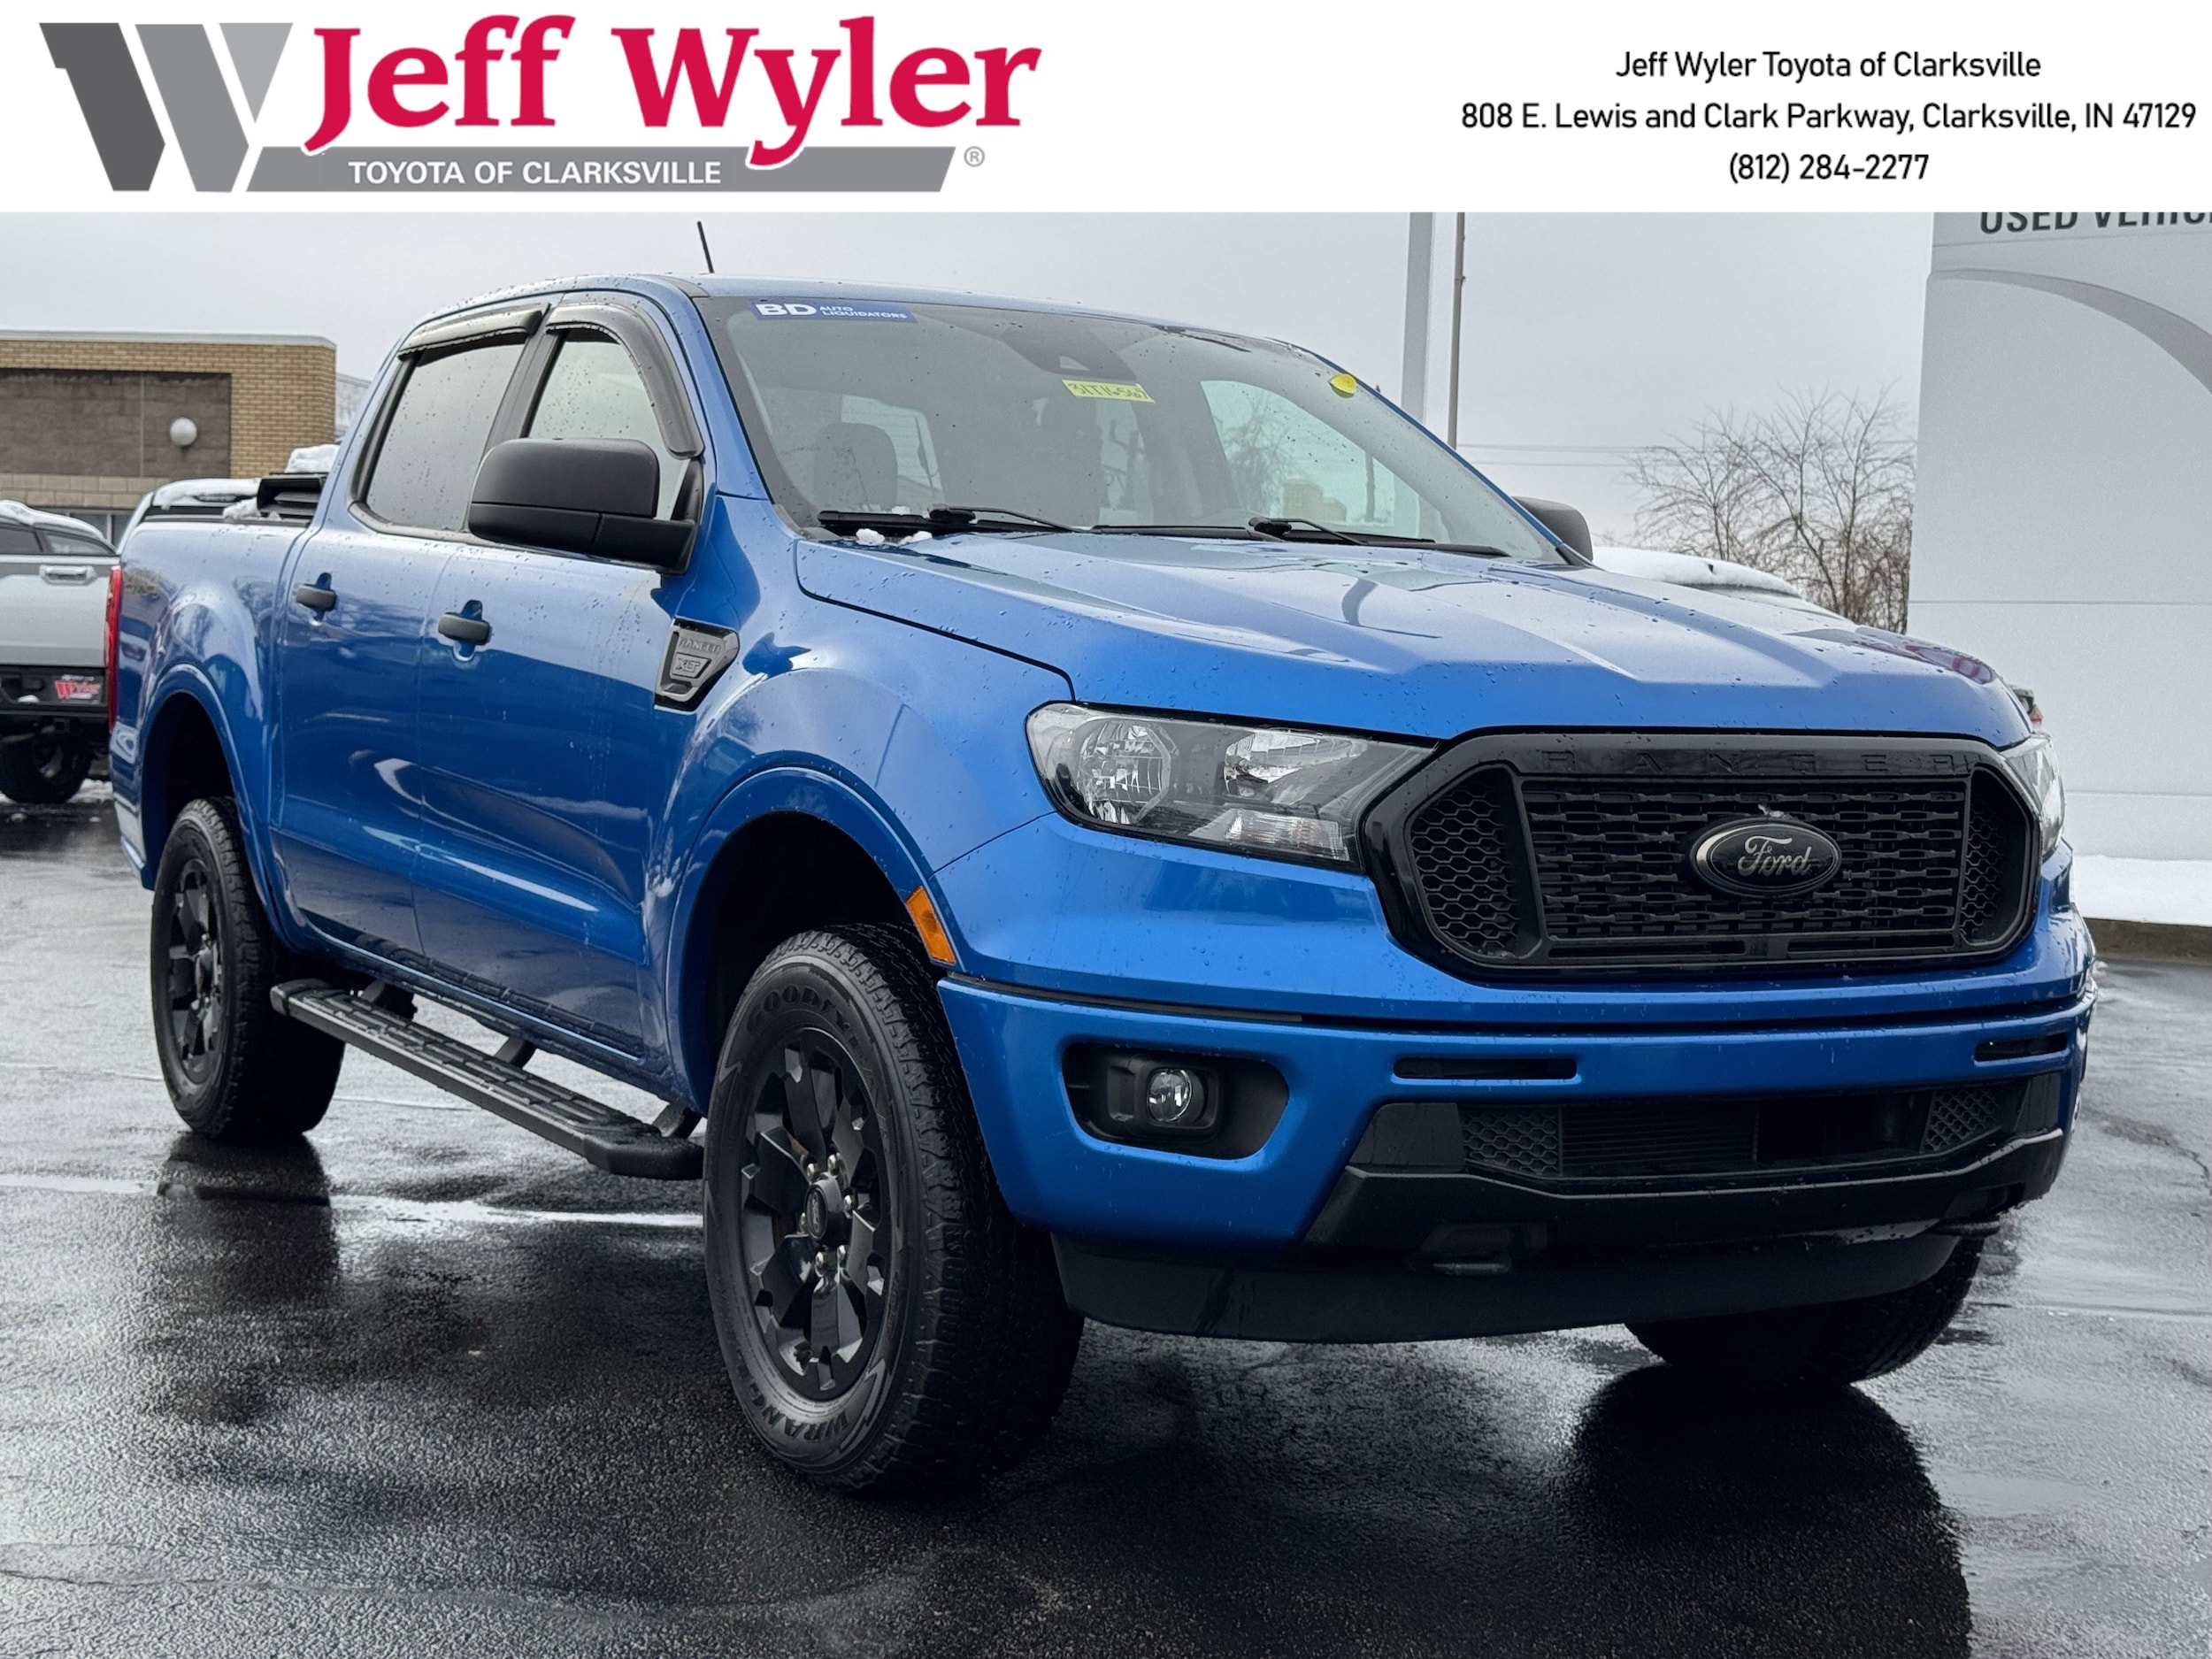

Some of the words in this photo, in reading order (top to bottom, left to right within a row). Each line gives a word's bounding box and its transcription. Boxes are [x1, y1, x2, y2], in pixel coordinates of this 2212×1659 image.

[755, 303, 818, 316] BD
[822, 311, 908, 319] LIQUIDATORS
[1540, 749, 1956, 772] RANGER
[1736, 834, 1812, 878] Ford
